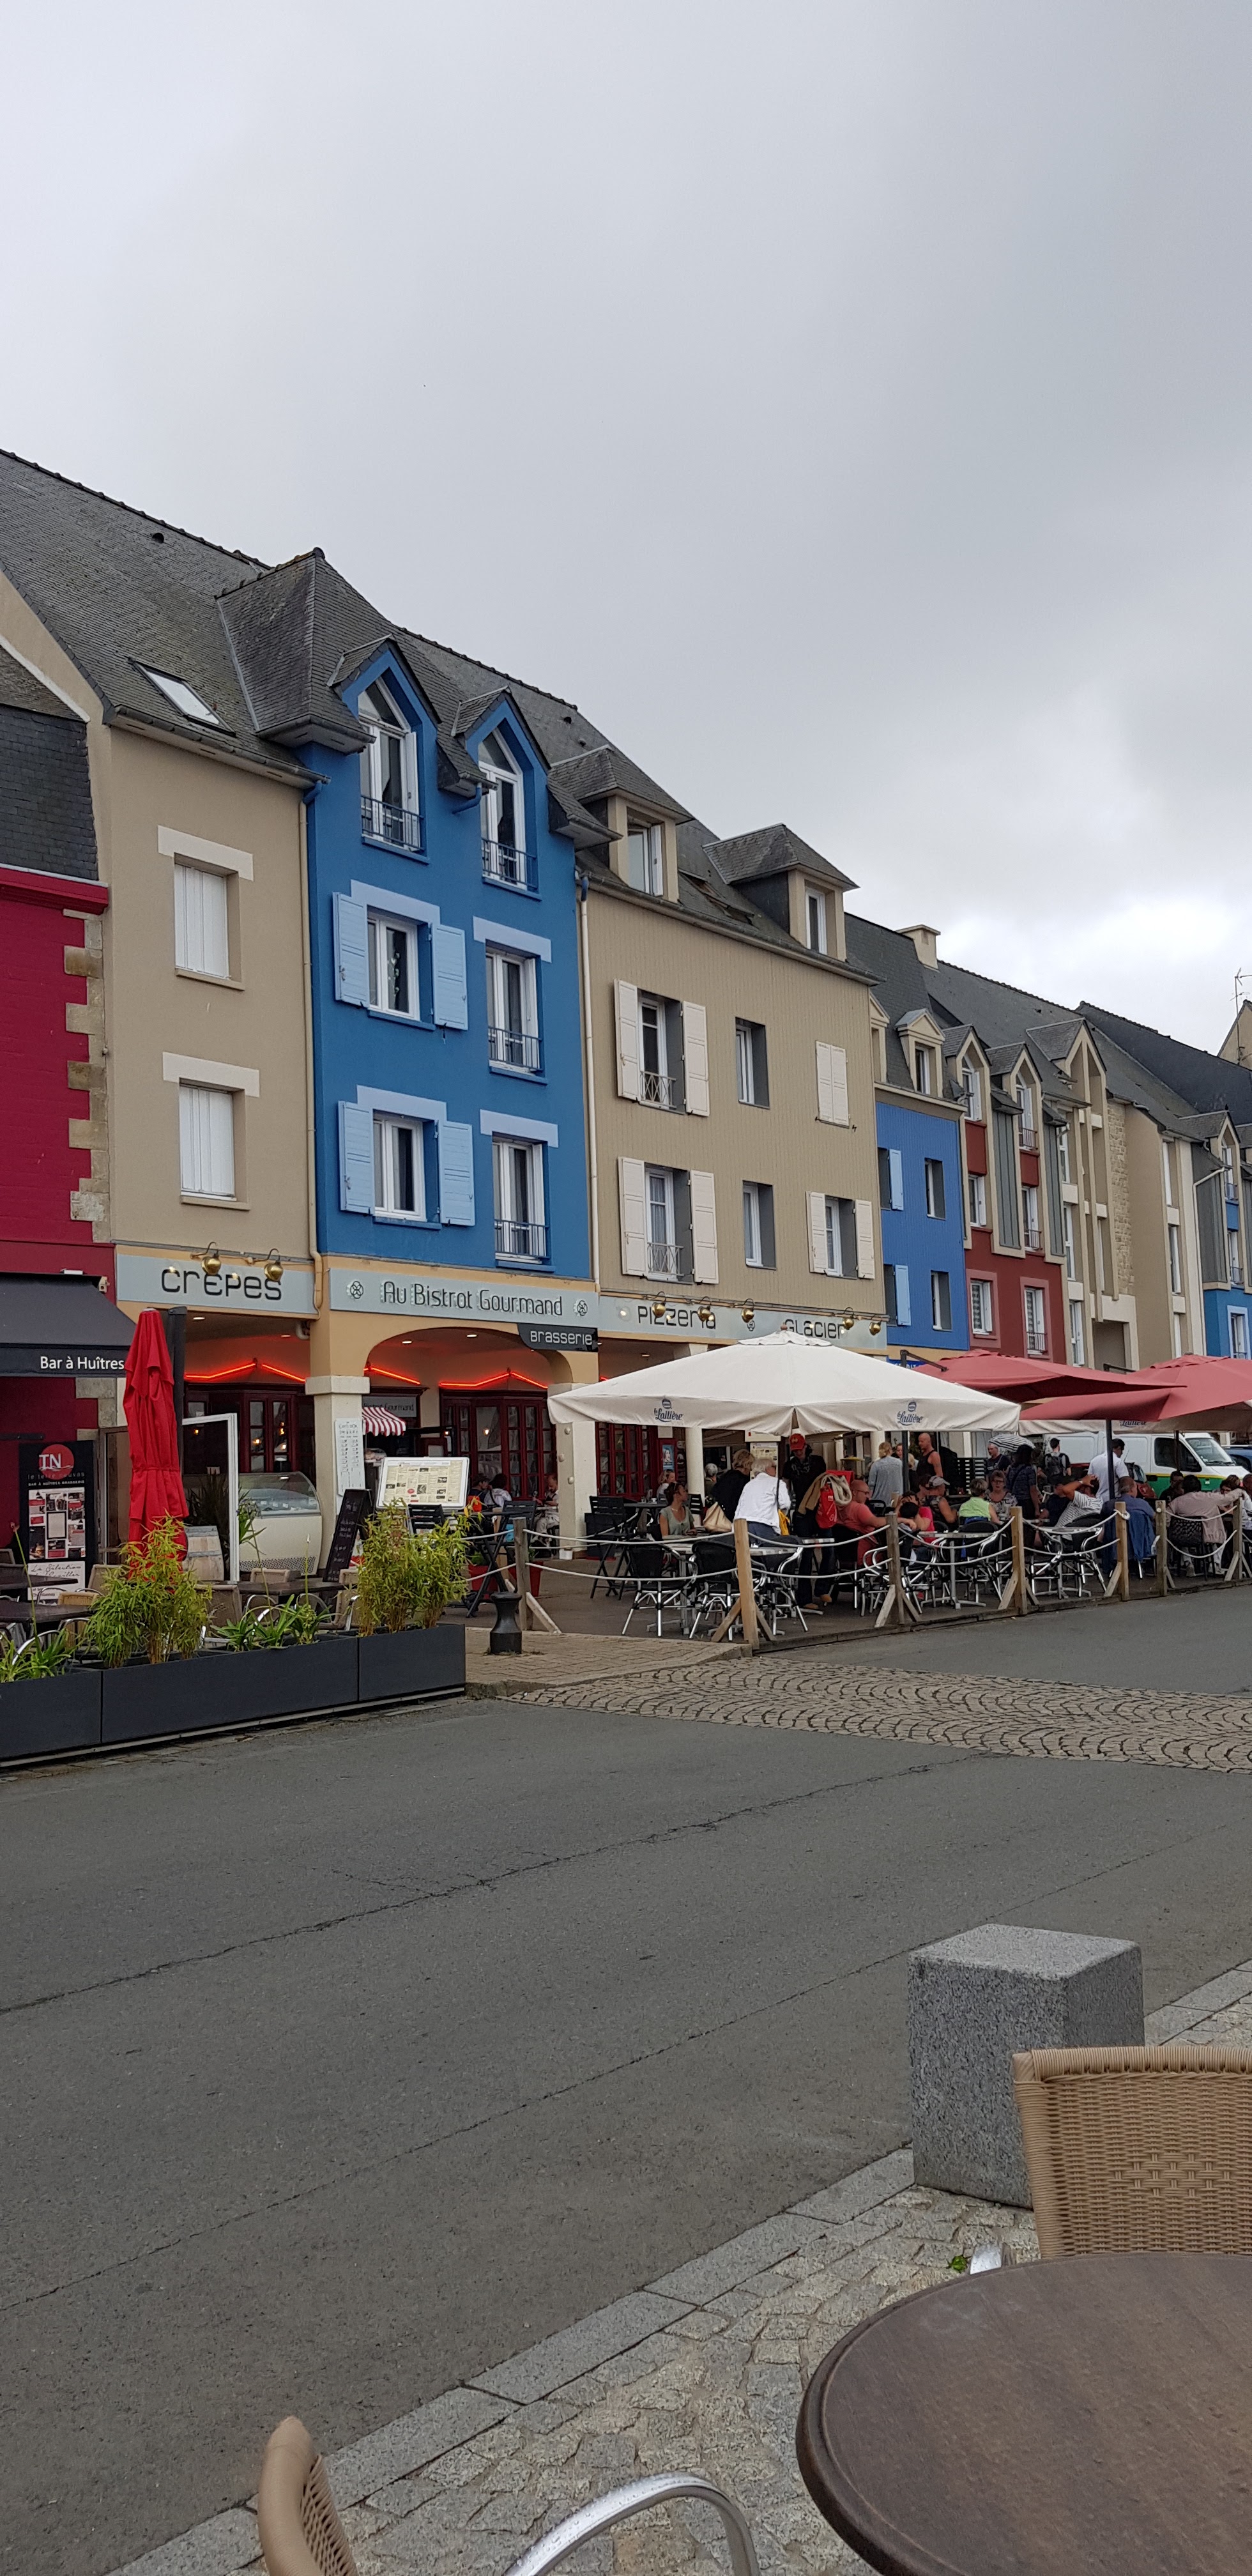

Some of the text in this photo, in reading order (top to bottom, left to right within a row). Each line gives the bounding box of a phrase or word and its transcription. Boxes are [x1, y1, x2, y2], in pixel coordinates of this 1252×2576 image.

[383, 1281, 562, 1316] Au Bistrot Gourmand
[530, 1330, 593, 1346] Brasserie
[40, 1356, 125, 1370] Bar à Huîtres
